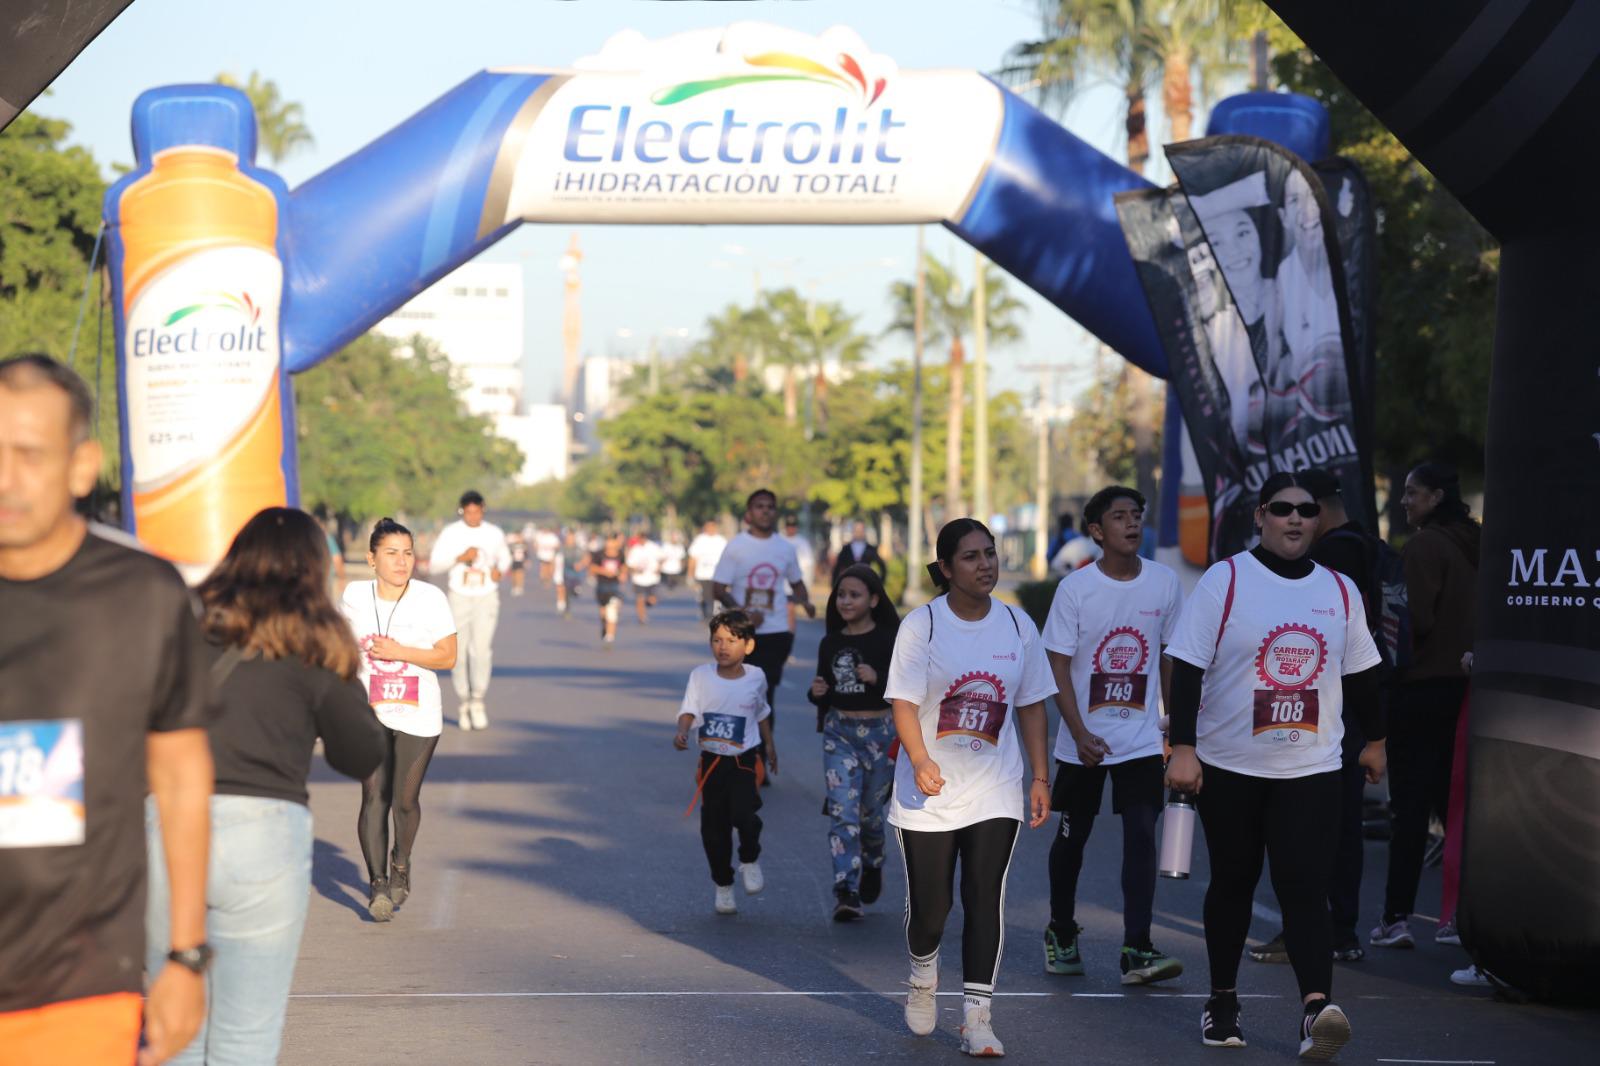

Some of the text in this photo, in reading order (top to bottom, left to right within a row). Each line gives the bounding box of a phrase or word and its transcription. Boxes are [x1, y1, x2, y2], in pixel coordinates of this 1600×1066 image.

[563, 104, 906, 165] Electrolit
[793, 173, 897, 194] TOTAL!
[133, 325, 267, 357] Electrolit
[1508, 548, 1600, 588] MA
[1507, 595, 1586, 607] GOBIERNO
[1273, 646, 1315, 656] CARRERA
[1278, 662, 1303, 676] 5K
[1104, 683, 1133, 701] 149
[958, 707, 990, 732] 131
[1270, 700, 1305, 722] 108
[706, 720, 736, 739] 343
